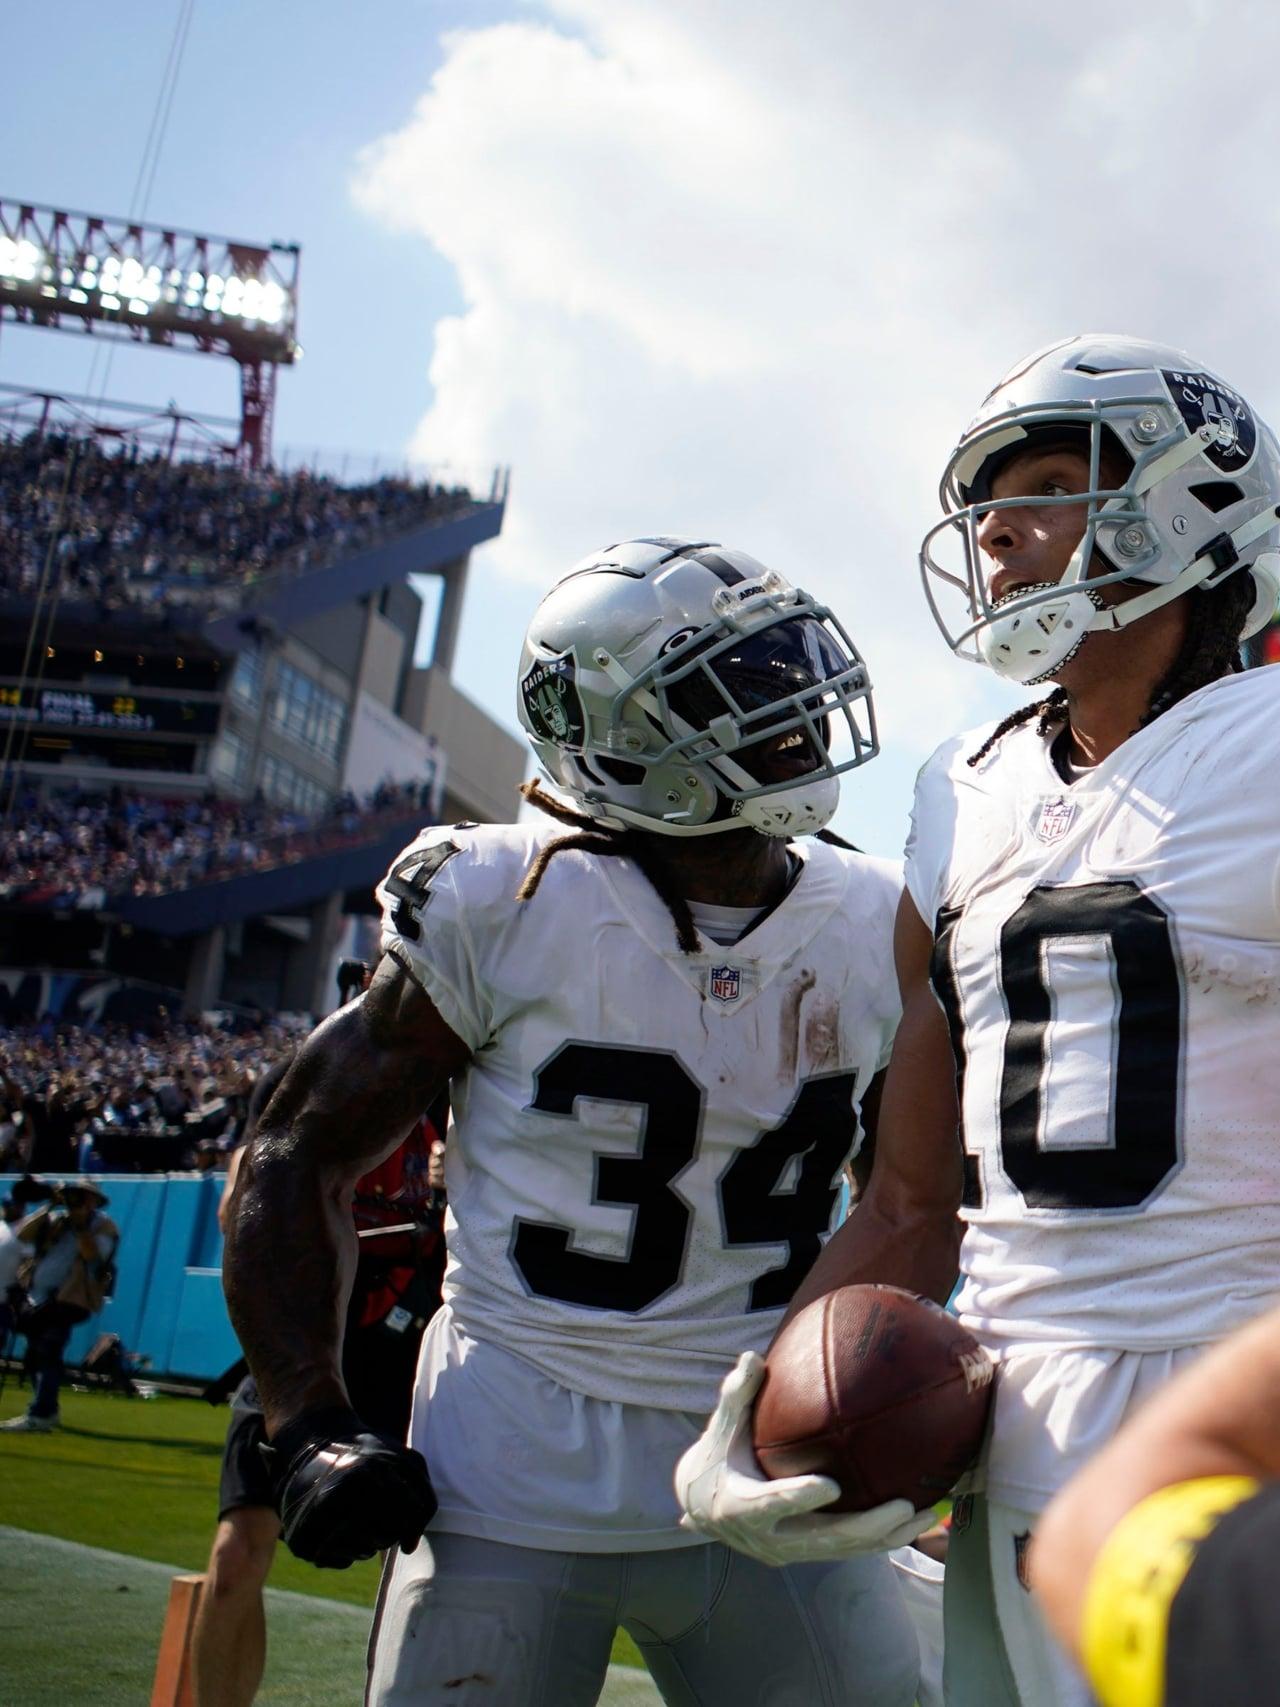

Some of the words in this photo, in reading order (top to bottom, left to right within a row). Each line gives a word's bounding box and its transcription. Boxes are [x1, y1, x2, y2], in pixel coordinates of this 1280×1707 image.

[523, 659, 568, 693] RAIDERS
[1041, 817, 1064, 836] NFL
[714, 980, 737, 997] NFL
[508, 1038, 861, 1315] 34
